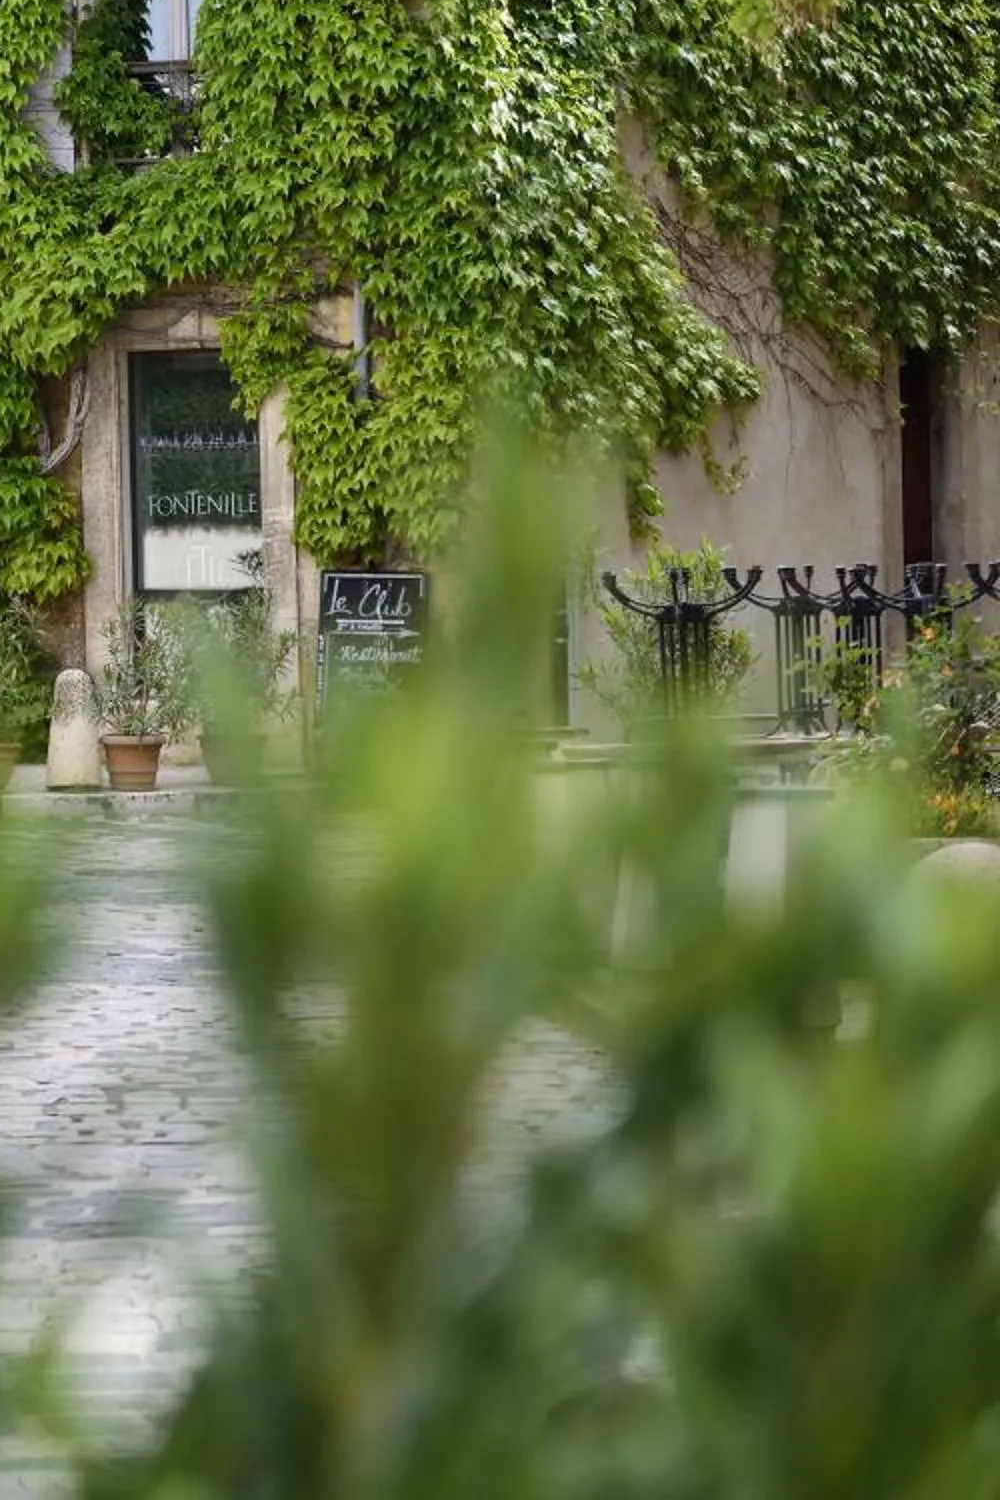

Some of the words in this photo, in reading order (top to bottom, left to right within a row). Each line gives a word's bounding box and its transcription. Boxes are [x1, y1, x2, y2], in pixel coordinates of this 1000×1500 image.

[148, 489, 259, 518] FONTENILLE
[326, 579, 353, 616] Le
[357, 582, 411, 621] Club
